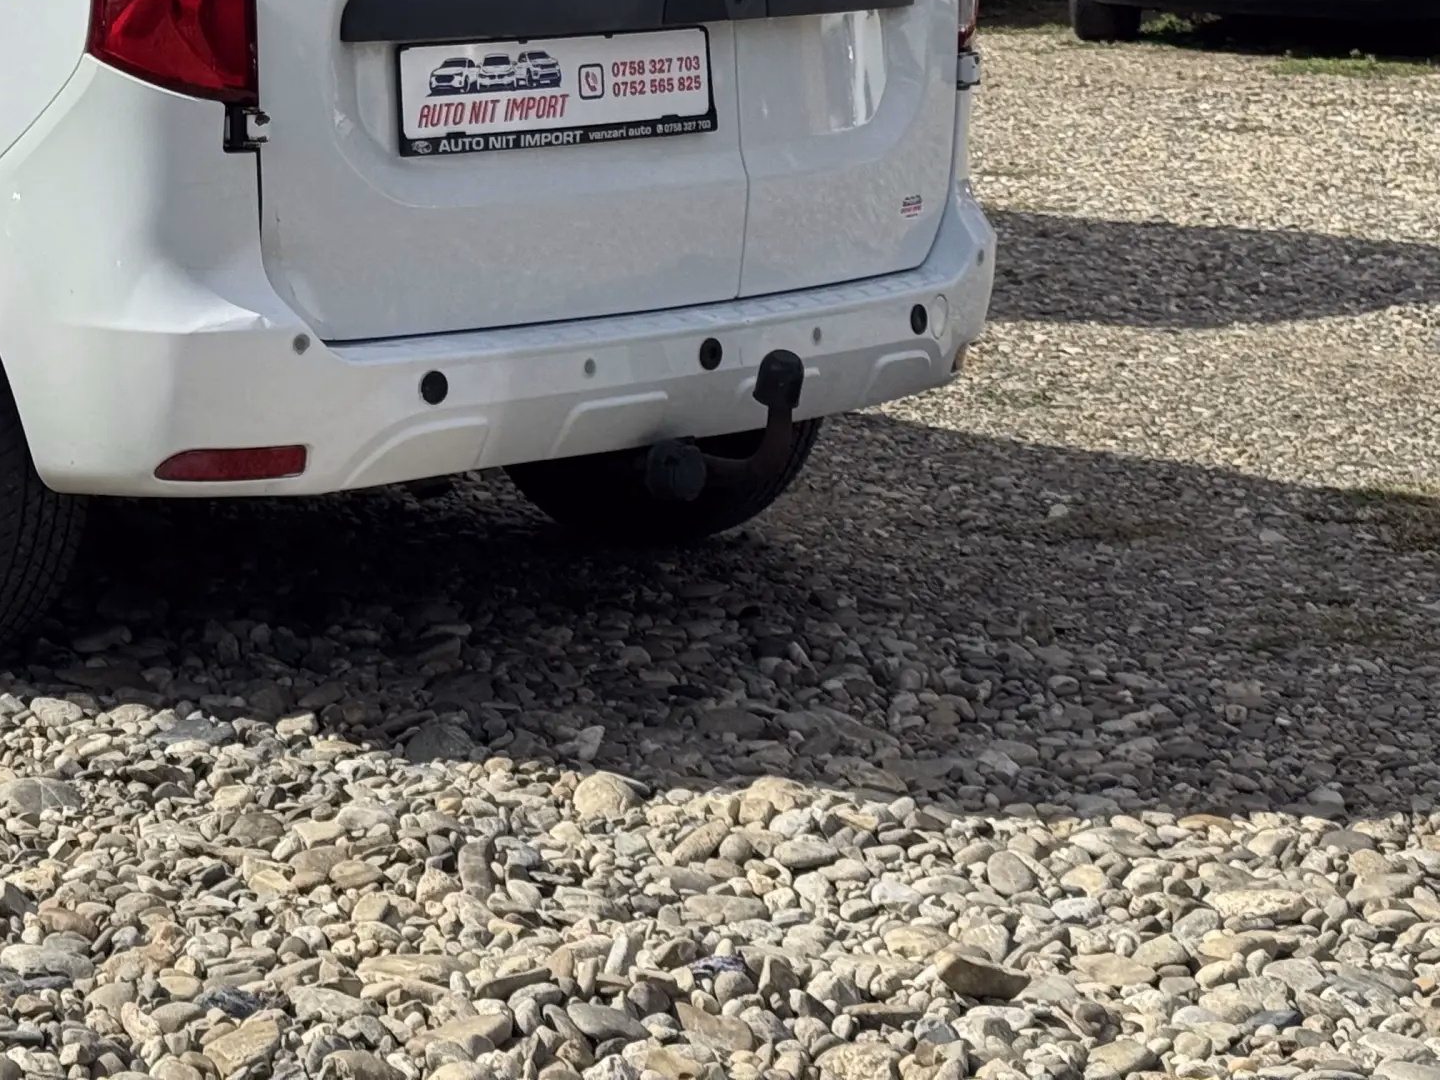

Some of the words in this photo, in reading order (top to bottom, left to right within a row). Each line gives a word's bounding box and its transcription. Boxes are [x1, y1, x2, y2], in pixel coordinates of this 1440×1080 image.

[611, 60, 645, 77] 0758
[649, 58, 673, 74] 327
[676, 56, 700, 72] 703
[612, 80, 646, 97] 0752
[650, 78, 674, 94] 565
[677, 75, 701, 91] 825
[418, 101, 465, 128] AUTO
[469, 99, 501, 125] NIT
[504, 94, 570, 122] IMPORT
[438, 137, 484, 153] AUTO
[489, 135, 517, 149] NIT
[520, 131, 583, 147] IMPORT
[588, 126, 626, 140] vanzari
[628, 126, 652, 136] auto
